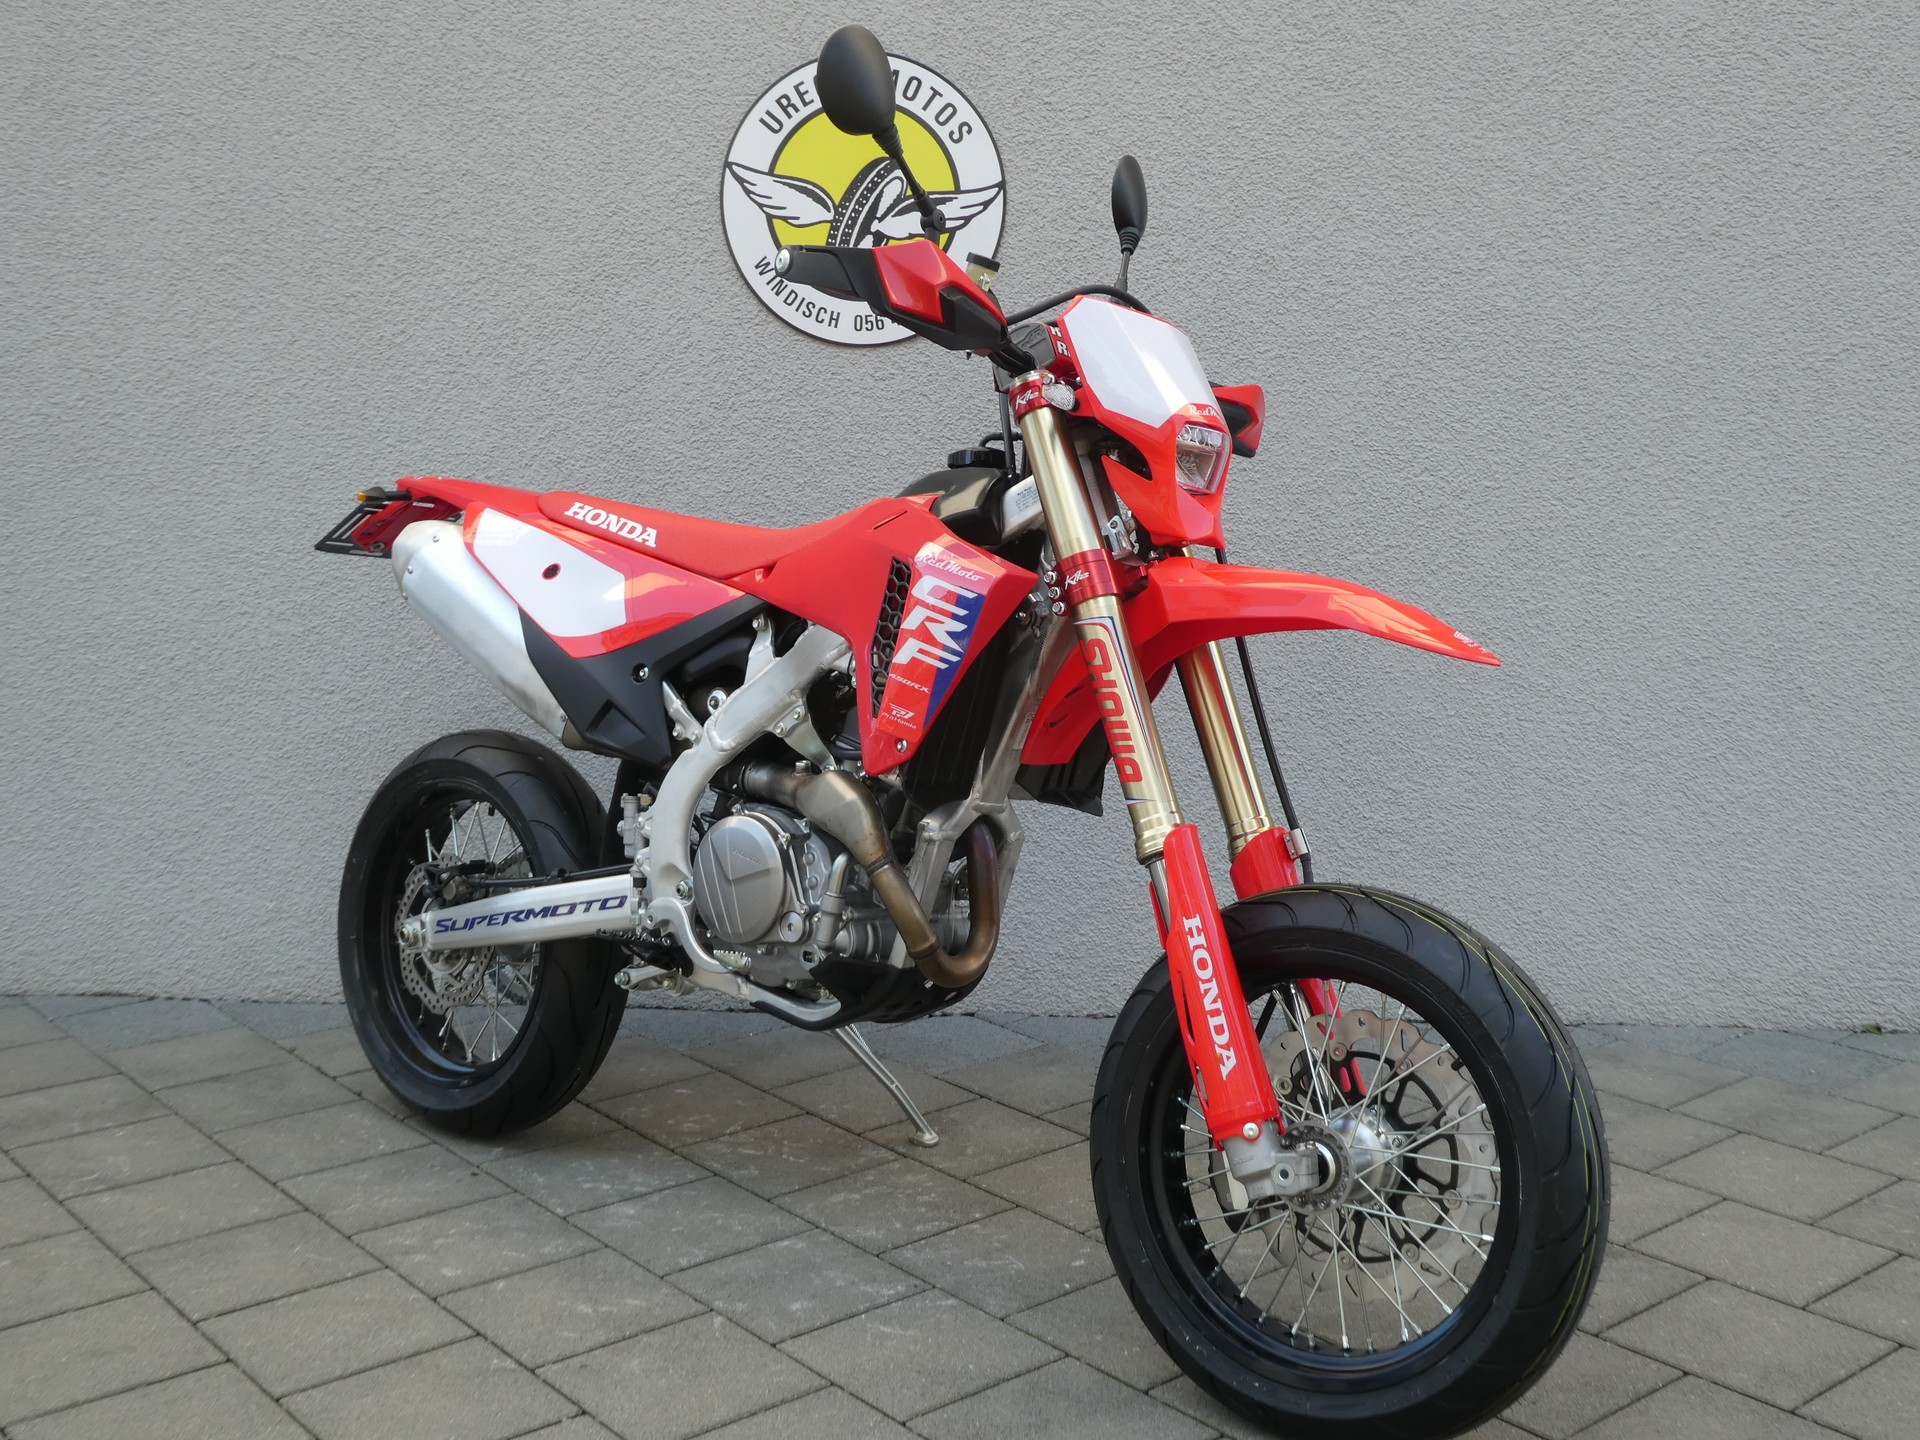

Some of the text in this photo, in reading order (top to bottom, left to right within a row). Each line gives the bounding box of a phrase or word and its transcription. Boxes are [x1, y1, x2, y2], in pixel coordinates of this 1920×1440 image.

[754, 256, 841, 328] WINDISCH
[563, 501, 658, 548] HONDA
[892, 574, 979, 670] CRF
[433, 895, 628, 935] SUPERMOTO
[1182, 913, 1238, 1081] HONDA
